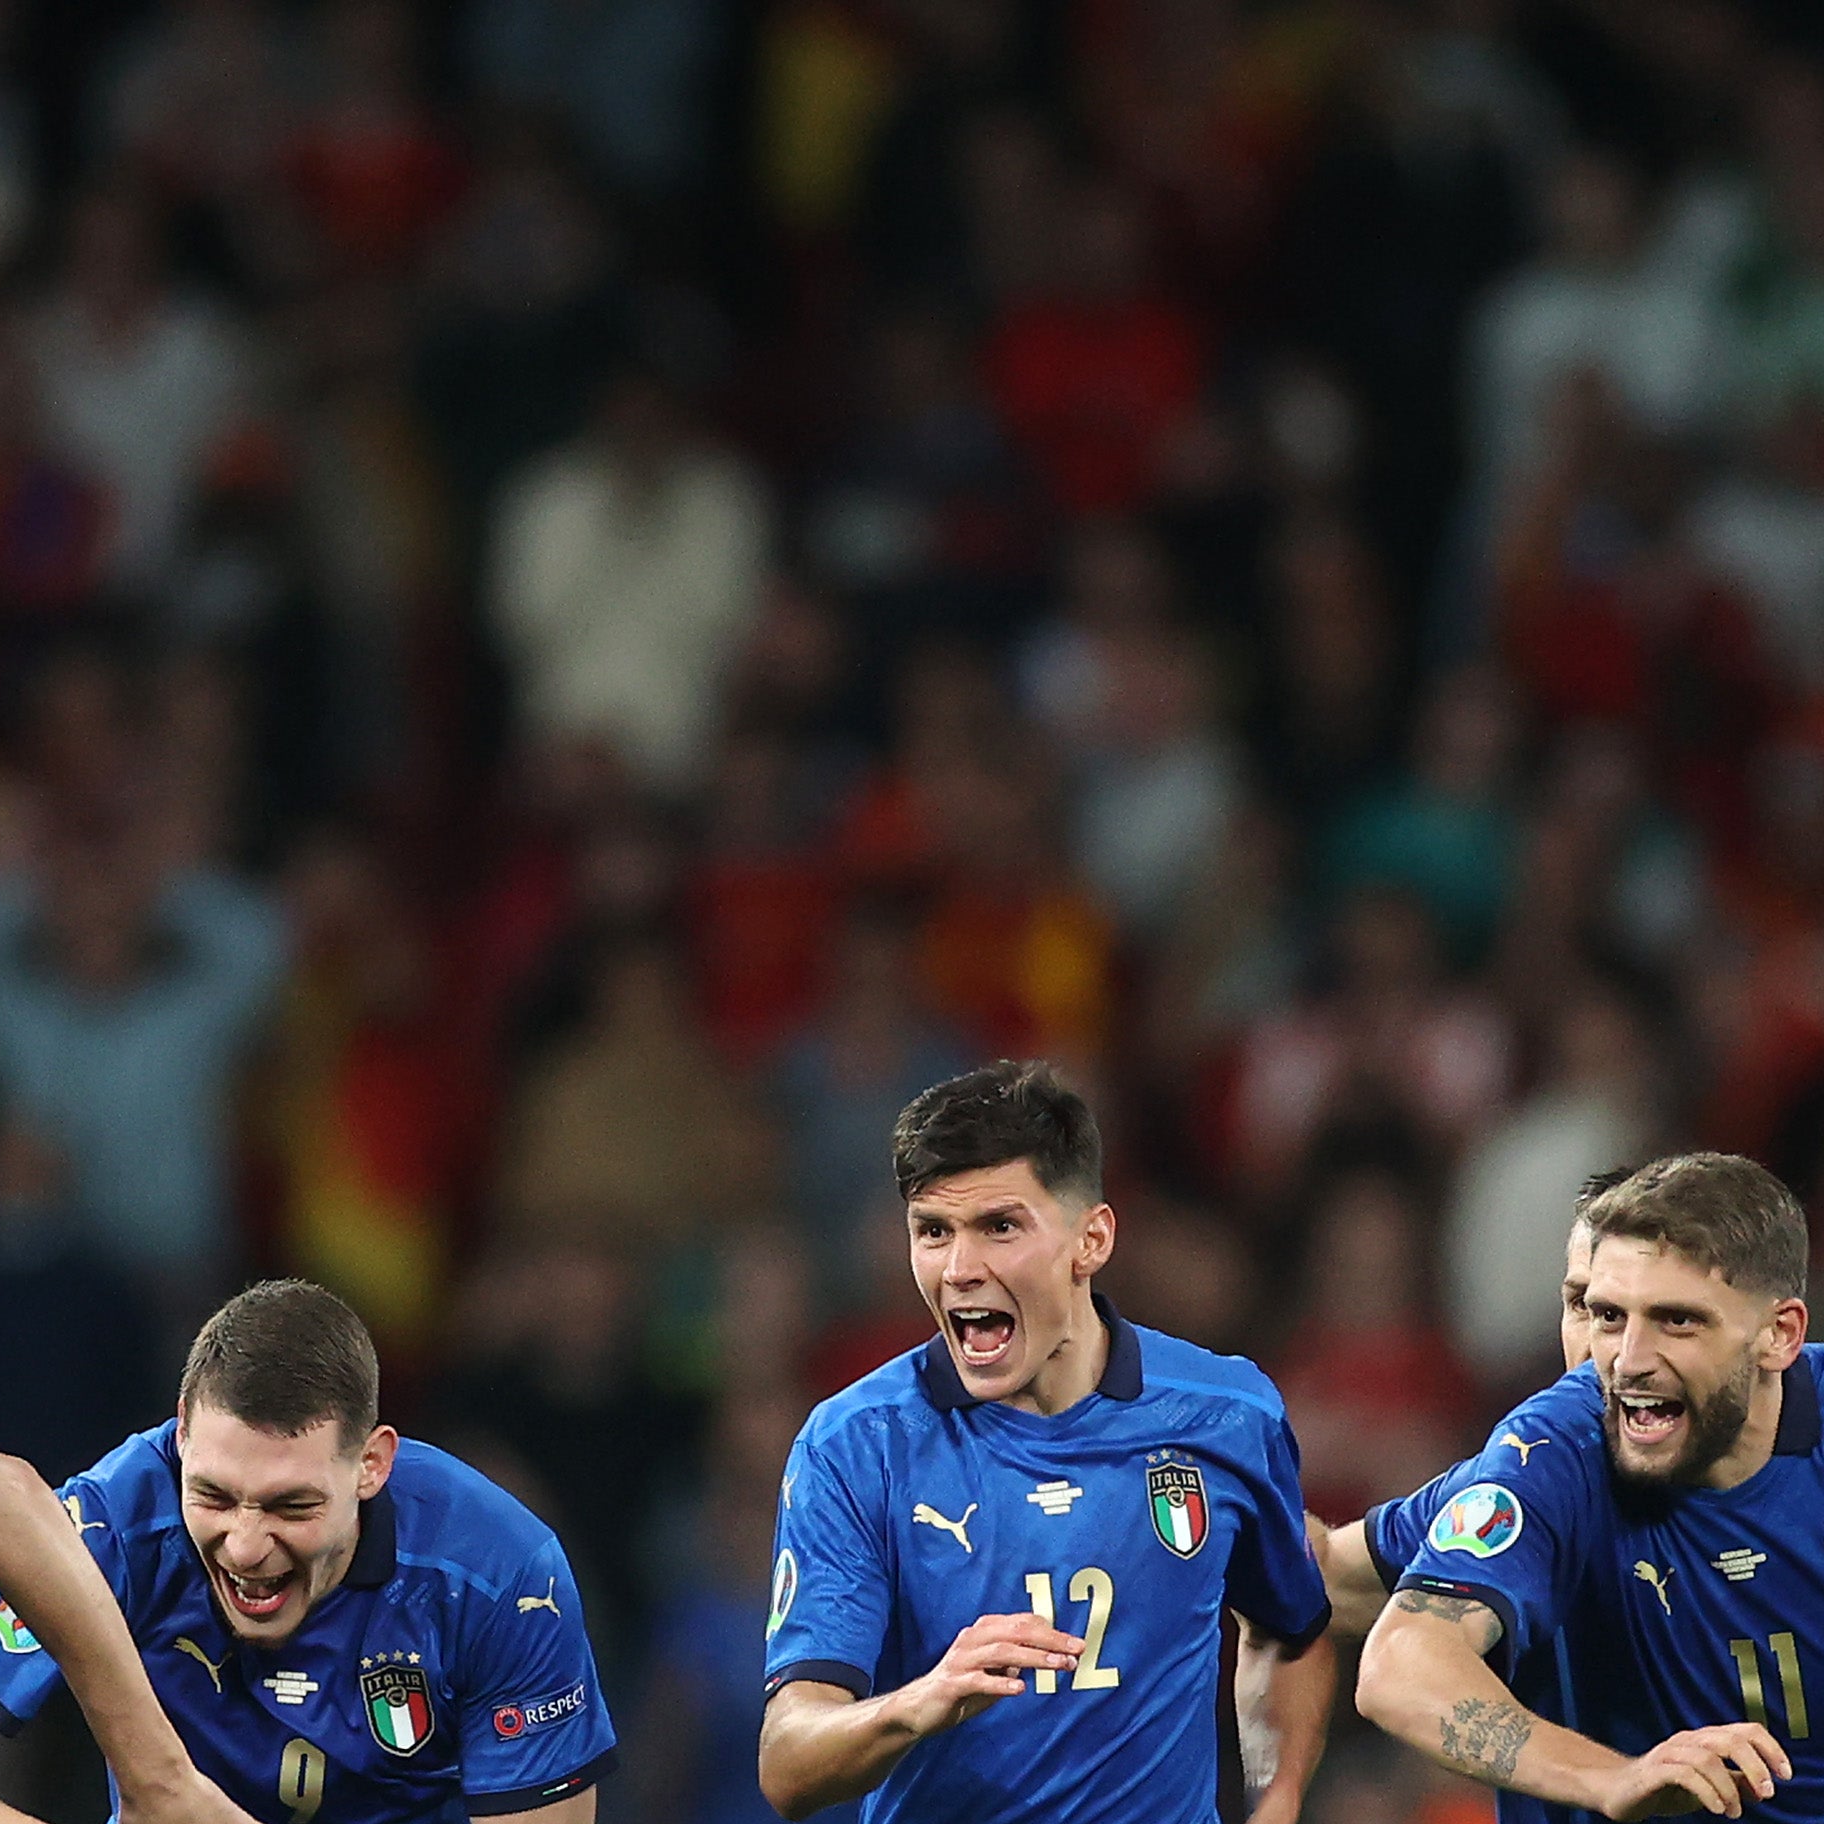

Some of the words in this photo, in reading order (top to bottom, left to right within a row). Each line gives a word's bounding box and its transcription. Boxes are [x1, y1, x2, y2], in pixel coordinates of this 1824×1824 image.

[1152, 1472, 1197, 1488] ITALIA
[1025, 1567, 1120, 1694] 12
[367, 1673, 421, 1694] ITALIA
[1730, 1632, 1809, 1739] 11
[525, 1684, 585, 1724] RESPECT
